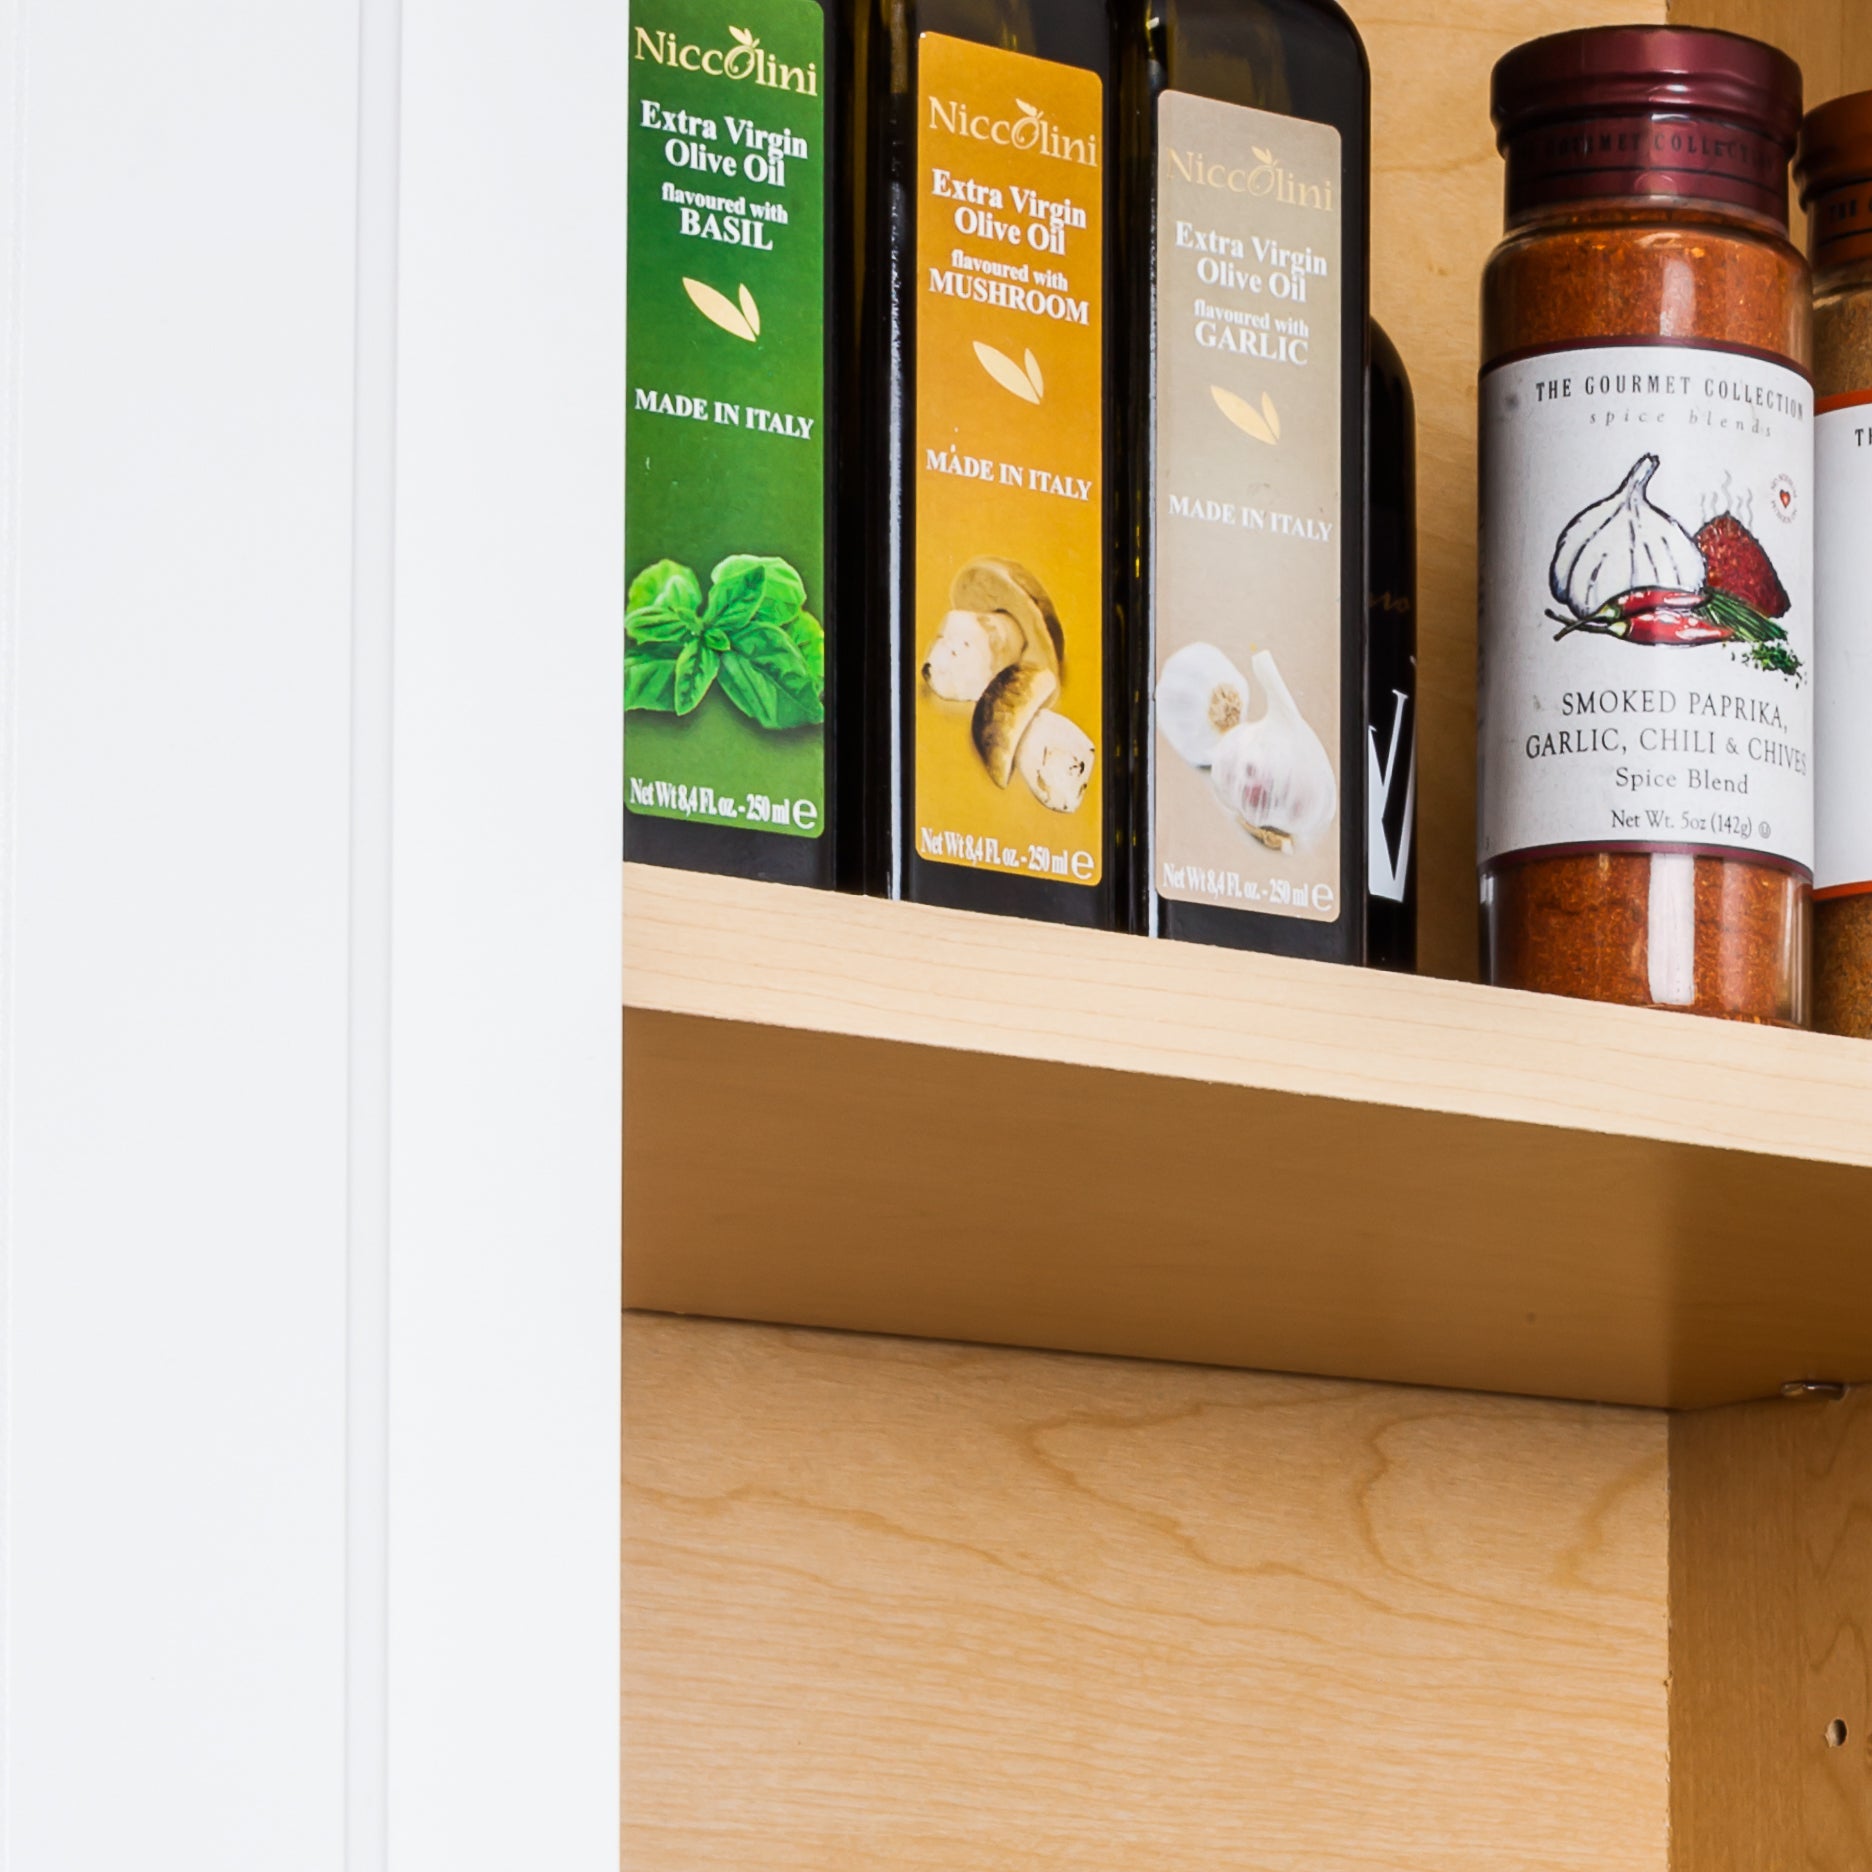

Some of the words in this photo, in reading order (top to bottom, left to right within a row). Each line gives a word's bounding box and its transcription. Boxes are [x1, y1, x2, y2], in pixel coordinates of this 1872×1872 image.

[640, 99, 718, 140] Extra
[723, 116, 808, 160] Virgin
[664, 138, 738, 177] Olive
[743, 153, 785, 187] Oil
[661, 181, 746, 216] flavoured
[749, 201, 788, 225] with
[931, 167, 1003, 209] Extra
[1008, 185, 1087, 230] Virgin
[679, 207, 774, 251] BASIL
[954, 206, 1021, 246] Olive
[1027, 222, 1066, 256] Oil
[1175, 220, 1244, 259] Extra
[1250, 235, 1328, 277] Virgin
[951, 248, 1029, 283] flavoured
[1032, 269, 1069, 293] with
[1196, 256, 1263, 294] Olive
[1268, 271, 1307, 303] Oil
[928, 267, 1089, 326] MUSHROOM
[1193, 298, 1271, 330] flavoured
[1274, 316, 1310, 339] with
[1194, 320, 1310, 366] GARLIC
[634, 388, 709, 421] MADE
[713, 401, 740, 427] IN
[745, 406, 814, 440] ITALY
[1535, 377, 1573, 403] THE
[1584, 374, 1692, 396] GOURMET
[1703, 377, 1805, 422] COLLECTION
[925, 448, 995, 482] MADE
[999, 462, 1024, 488] IN
[1028, 468, 1093, 501] ITALY
[1168, 494, 1237, 526] MADE
[1241, 506, 1265, 530] IN
[1270, 511, 1333, 543] ITALY
[1561, 689, 1677, 717] SMOKED
[1687, 691, 1789, 734] PAPRIKA,
[1525, 727, 1628, 760] GARLIC,
[1638, 727, 1716, 755] CHILI
[1725, 736, 1741, 756] &
[1747, 736, 1808, 777] CHIVES
[629, 777, 655, 806] Net
[746, 793, 771, 823] 250
[772, 798, 790, 826] ml
[1615, 766, 1678, 792] Spice
[1687, 768, 1749, 795] Blend
[1610, 808, 1641, 829] Net
[1644, 809, 1675, 830] Wt.
[1680, 810, 1706, 831] 5oz
[1710, 811, 1753, 840] (142g)
